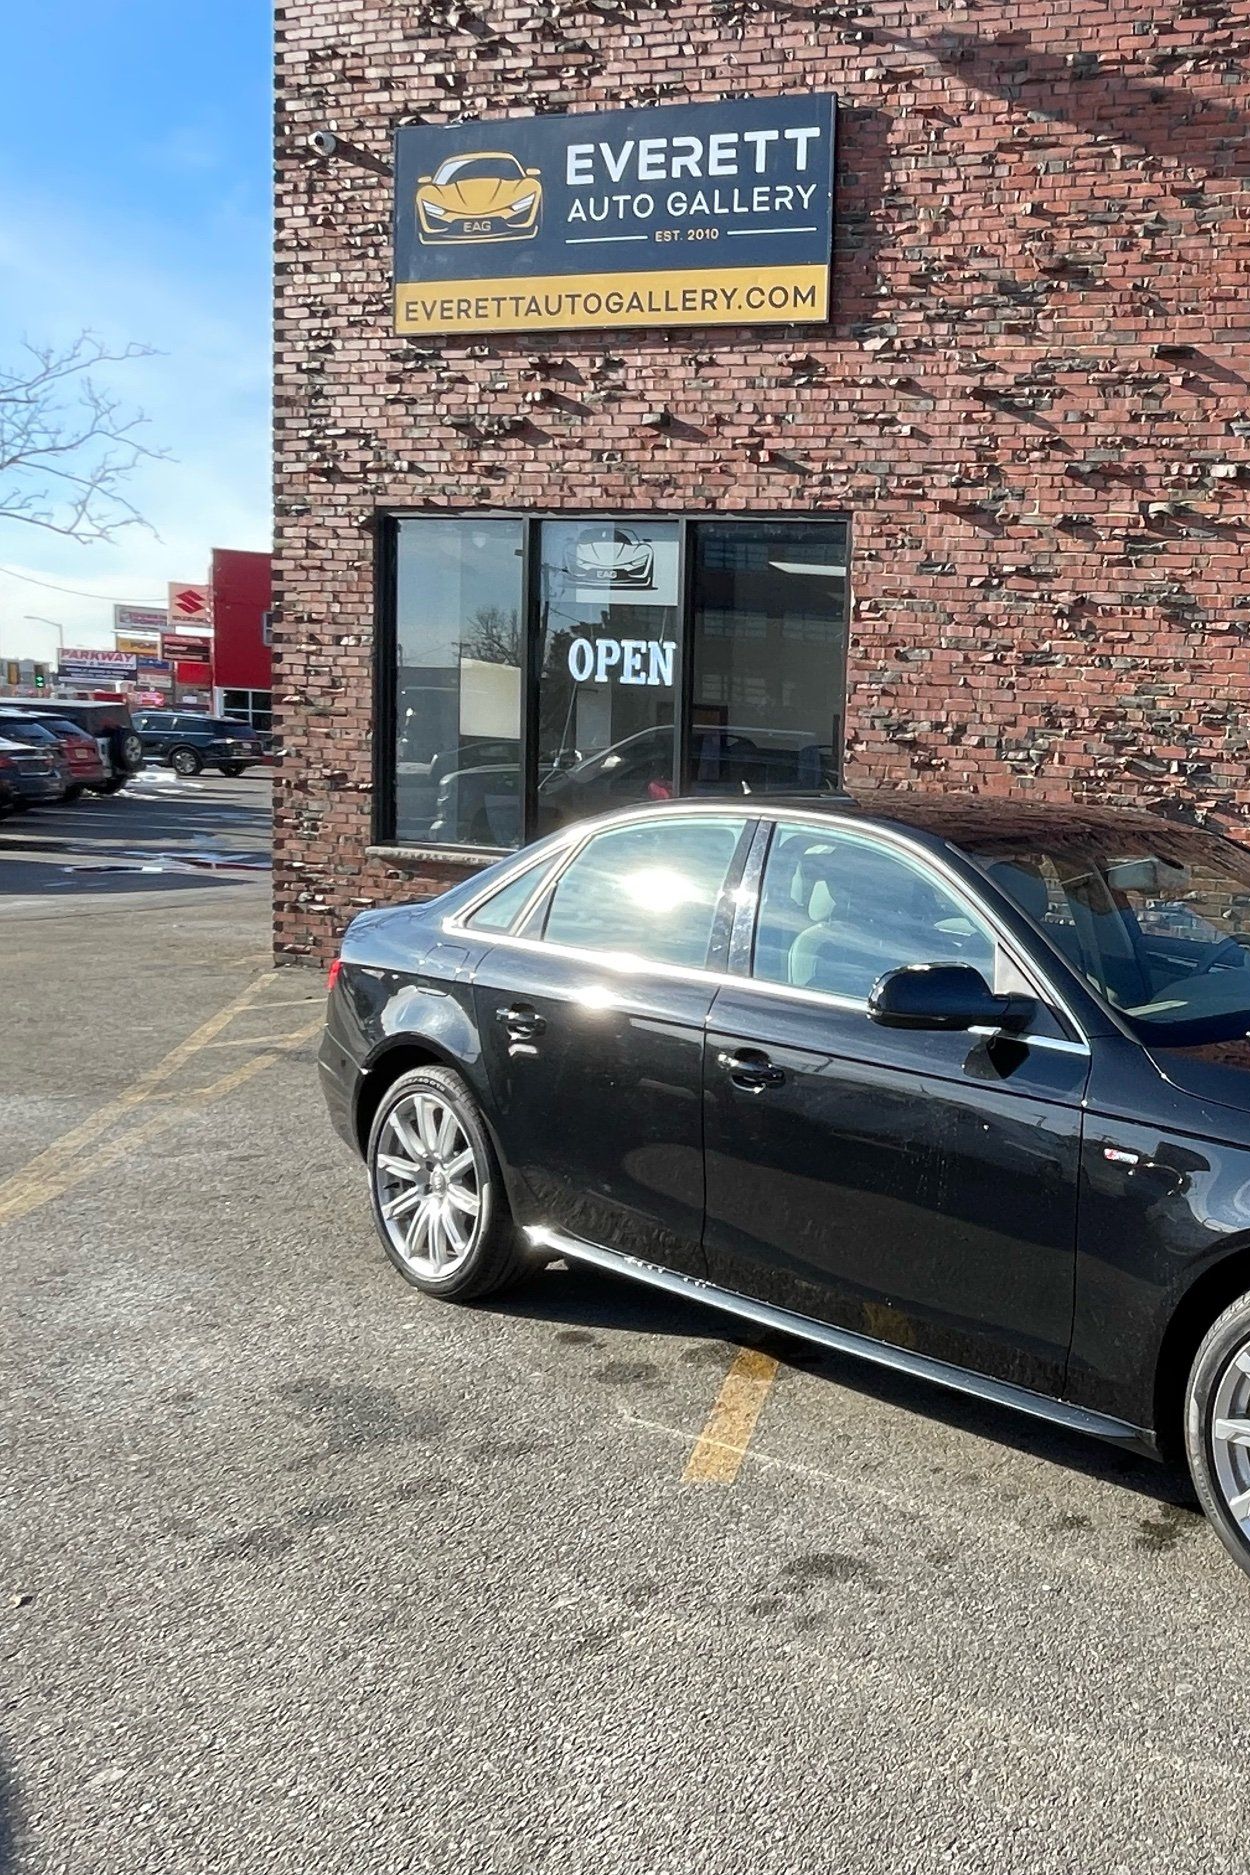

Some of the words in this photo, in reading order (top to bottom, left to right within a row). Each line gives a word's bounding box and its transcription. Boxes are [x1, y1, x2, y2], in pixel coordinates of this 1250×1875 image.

[566, 126, 821, 186] EVERETT
[567, 192, 655, 223] AUTO
[666, 183, 817, 215] GALLERY
[463, 220, 491, 233] EAG
[655, 230, 683, 242] EST.
[687, 228, 719, 241] 2010
[405, 284, 817, 322] EVERETTAUTOGALLERY.COM
[61, 648, 134, 663] PARKWAY
[568, 637, 676, 687] OPEN
